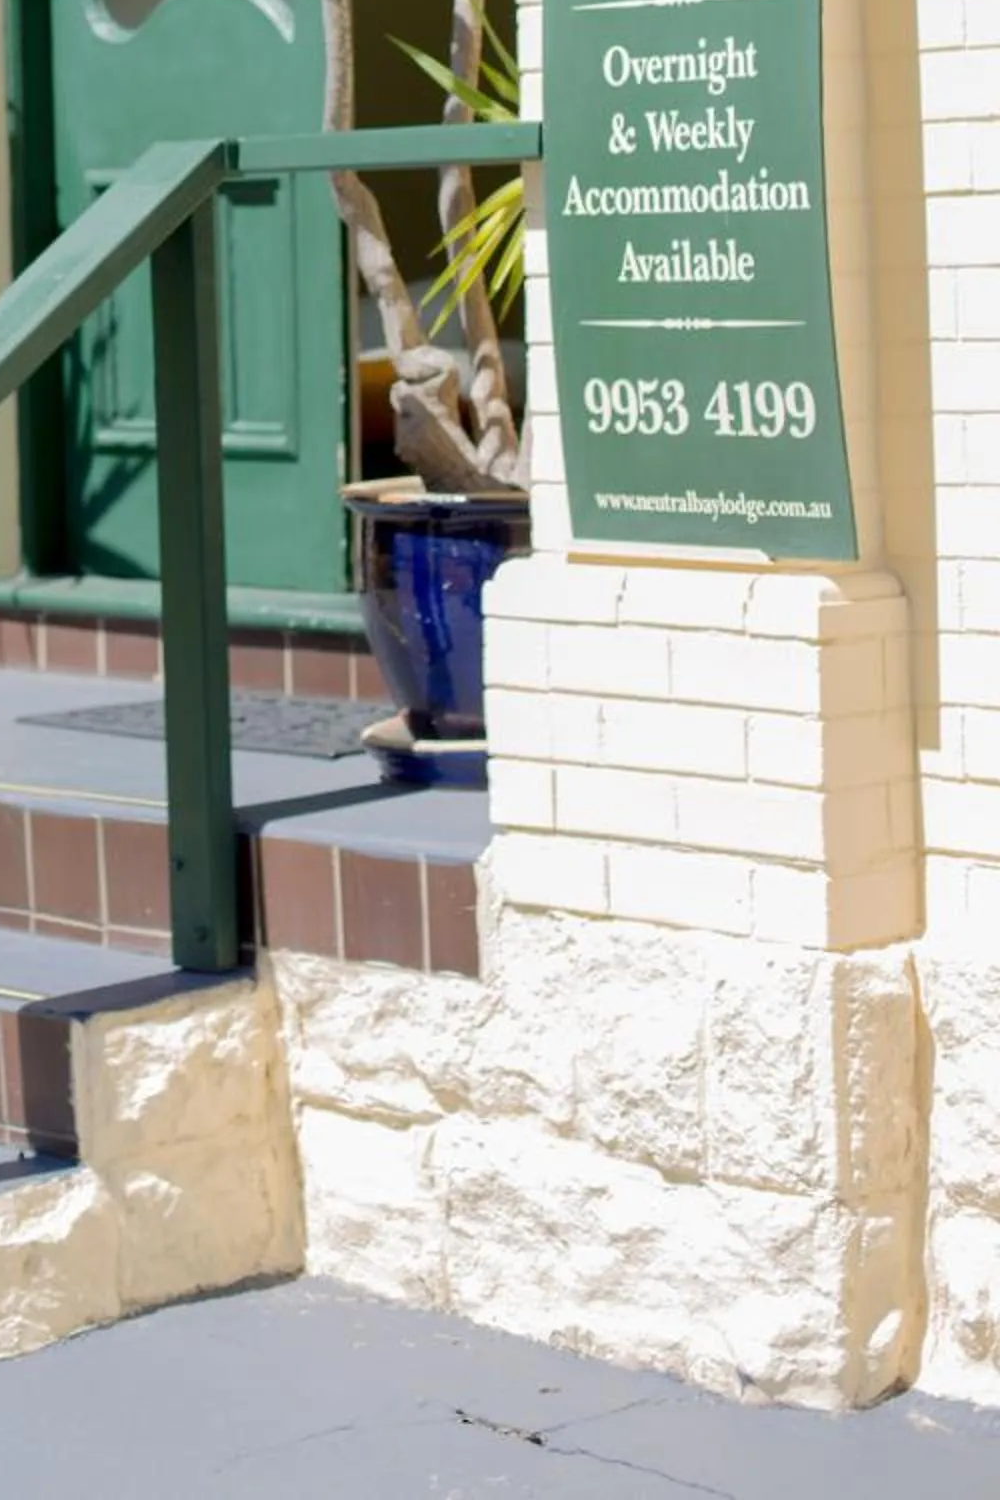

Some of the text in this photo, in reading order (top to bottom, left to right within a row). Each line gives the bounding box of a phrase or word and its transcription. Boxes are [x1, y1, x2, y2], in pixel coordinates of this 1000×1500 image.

[603, 36, 758, 95] Overnight
[608, 105, 755, 163] & Weekly
[562, 168, 811, 216] Accommodation
[617, 238, 755, 283] Available
[583, 377, 817, 439] 9953 4199
[595, 490, 833, 524] www.neutralbaylodge.com.au
